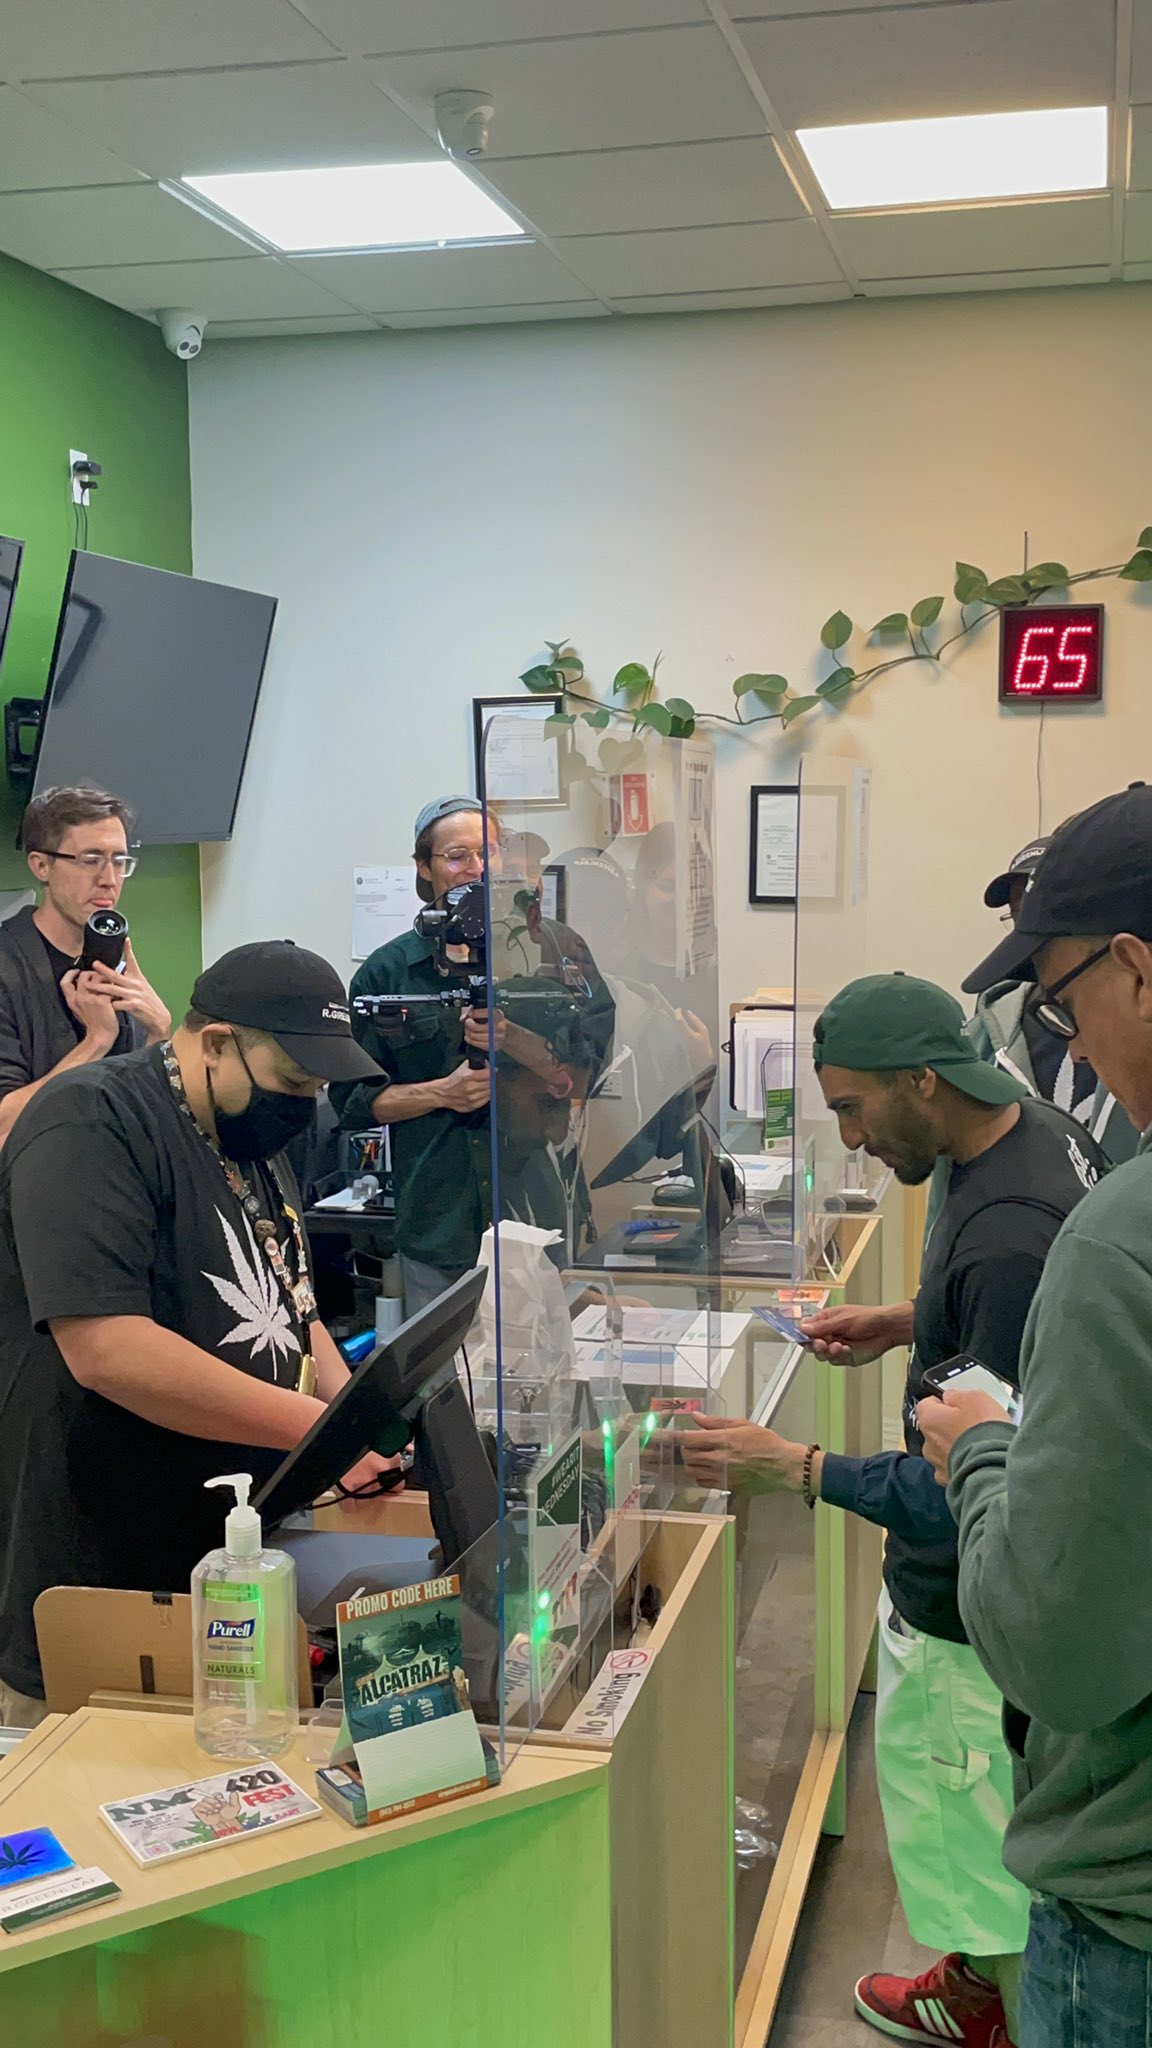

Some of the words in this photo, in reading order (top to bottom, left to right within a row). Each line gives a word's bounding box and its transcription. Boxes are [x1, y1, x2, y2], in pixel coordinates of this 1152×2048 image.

[1014, 626, 1093, 690] 65
[346, 1595, 389, 1619] PROMO
[391, 1584, 422, 1608] CODE
[424, 1575, 453, 1599] HERE
[212, 1621, 251, 1637] Purell
[207, 1664, 256, 1675] NATURALS
[361, 1655, 443, 1705] ALCATRAZ
[585, 1672, 641, 1717] Smoking
[575, 1720, 608, 1736] No
[108, 1788, 197, 1822] NM
[226, 1770, 283, 1793] 420
[242, 1784, 296, 1807] FEST
